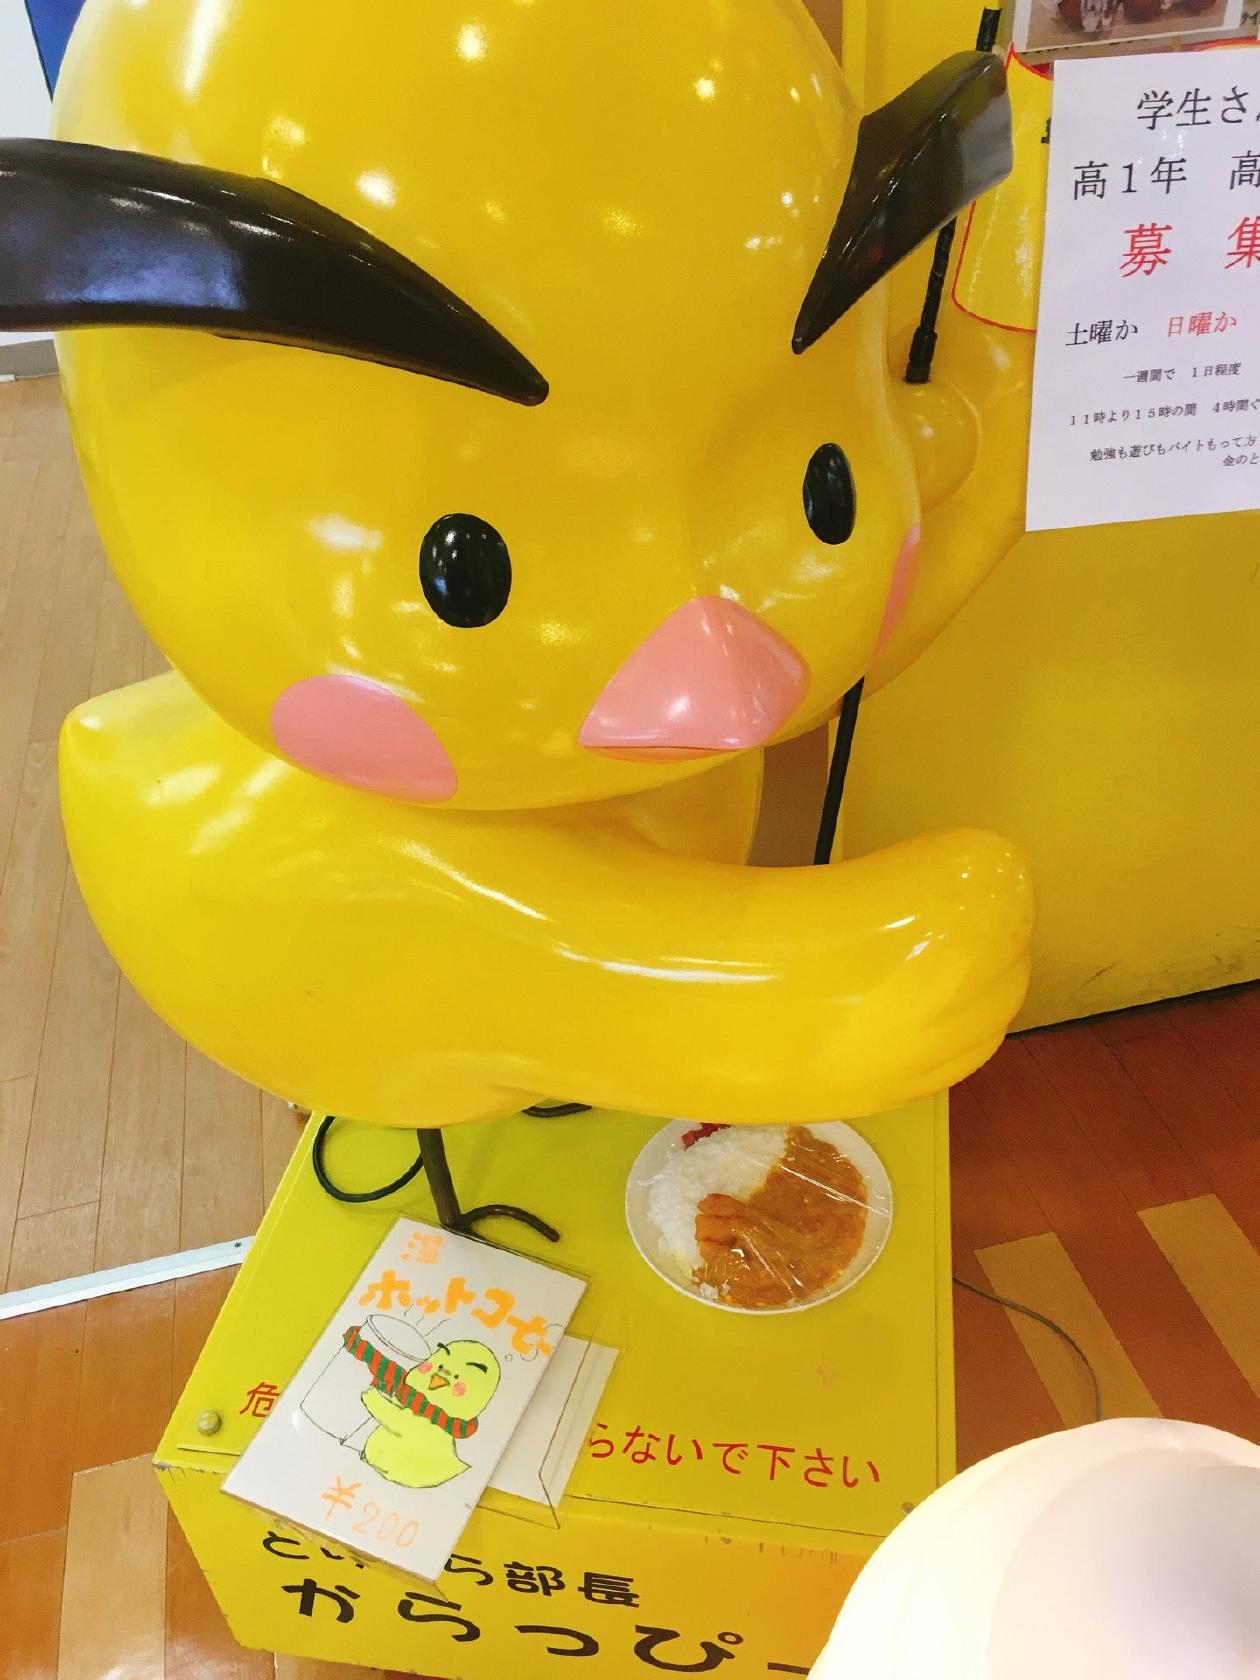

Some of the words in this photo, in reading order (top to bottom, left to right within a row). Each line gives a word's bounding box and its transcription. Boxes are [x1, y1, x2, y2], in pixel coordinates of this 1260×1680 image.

[1136, 85, 1260, 130] 学生さ
[1072, 156, 1188, 200] 高1年
[1065, 319, 1138, 347] 土曜か
[1167, 312, 1237, 338] 日曜か
[1123, 368, 1176, 383] 一週間で
[1191, 362, 1242, 378] 1日程度
[1069, 403, 1197, 426] 11時より15時の間
